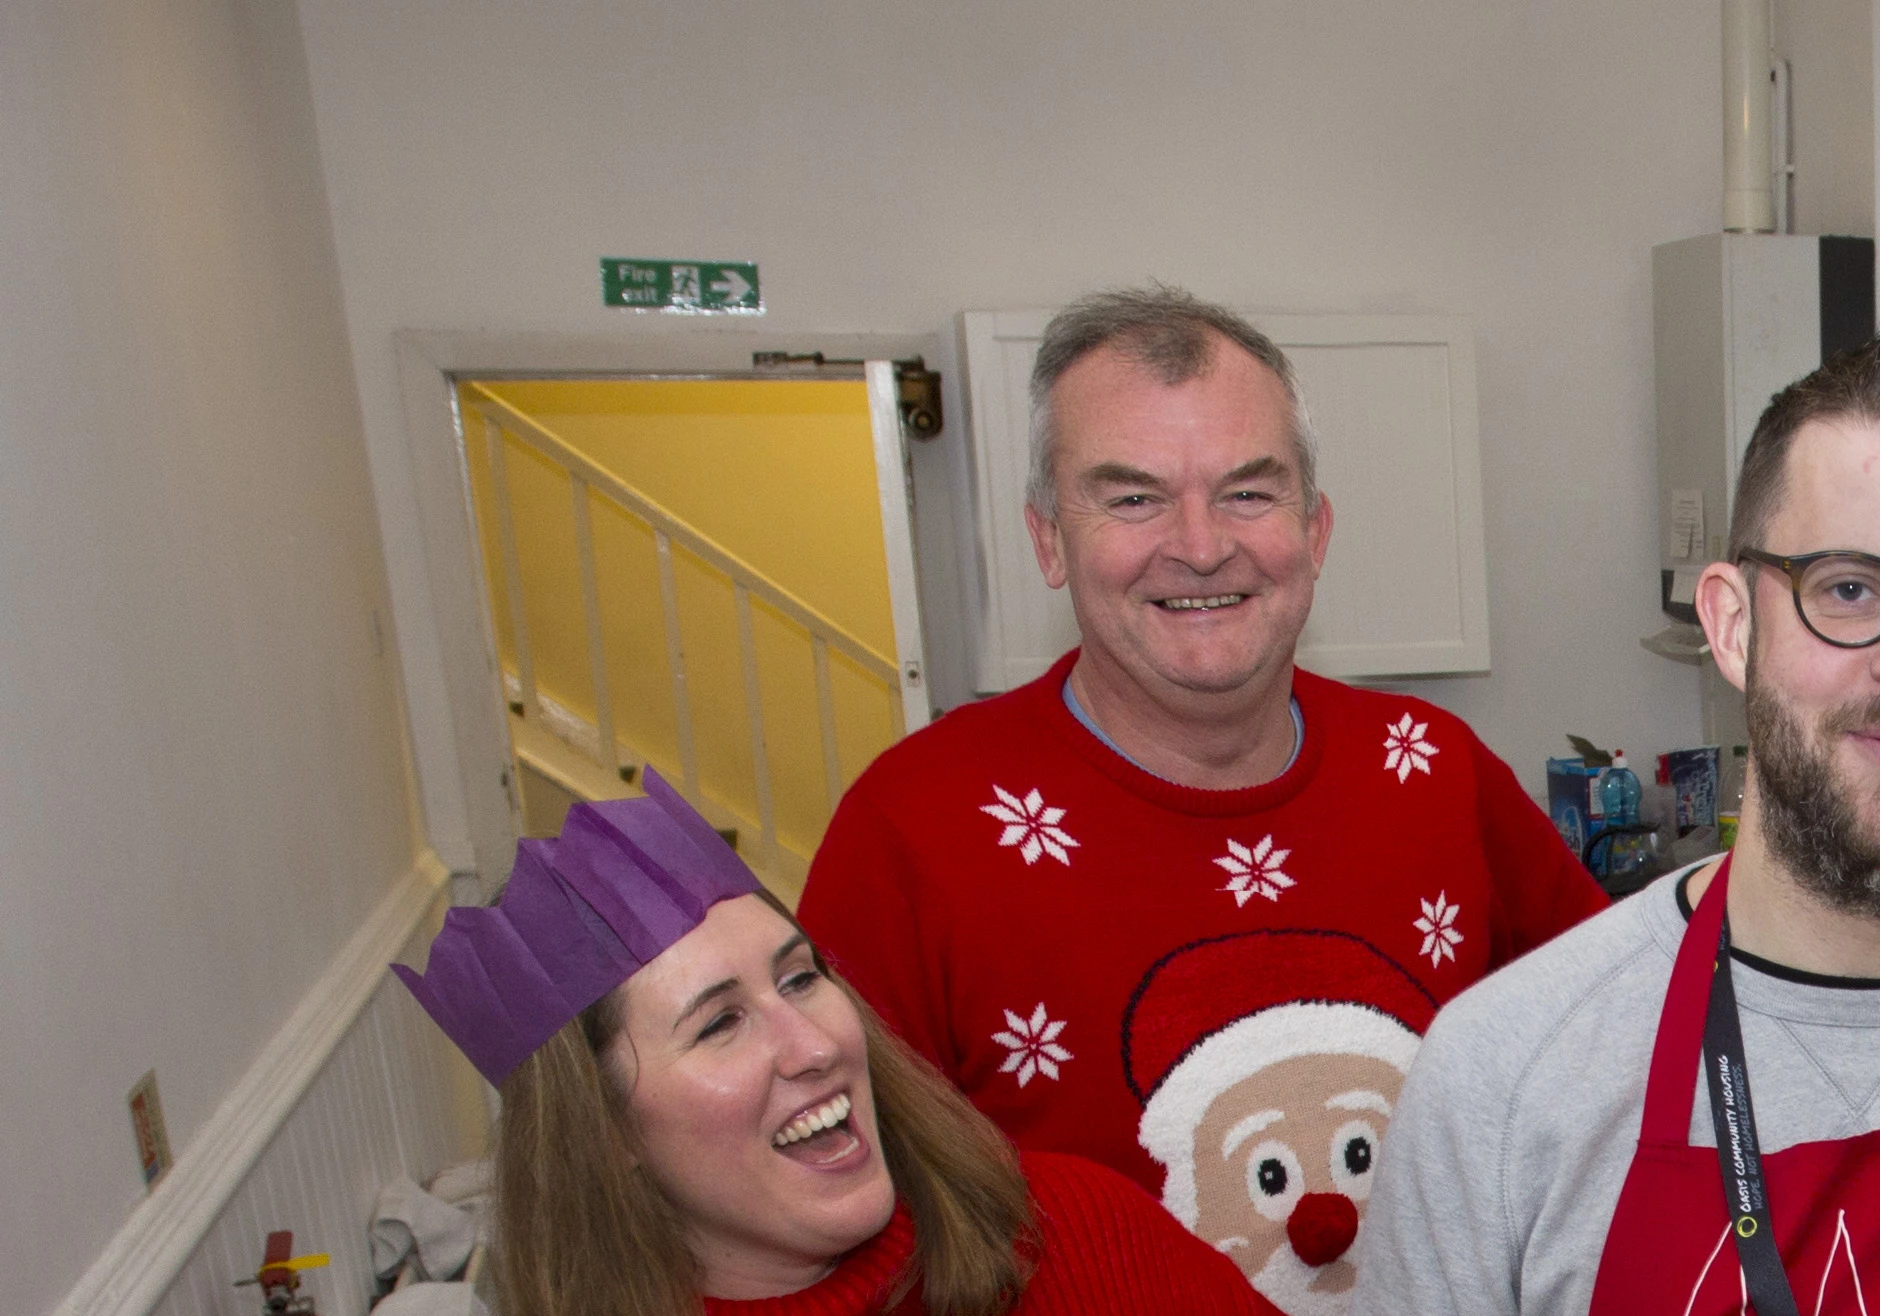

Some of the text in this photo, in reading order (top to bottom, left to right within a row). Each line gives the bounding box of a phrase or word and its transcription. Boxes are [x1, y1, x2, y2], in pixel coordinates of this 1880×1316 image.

[618, 264, 656, 283] Fire
[622, 285, 657, 302] exit
[1718, 1054, 1752, 1213] OASIS COMMUNITY HOUSING
[1745, 1155, 1758, 1175] NOT
